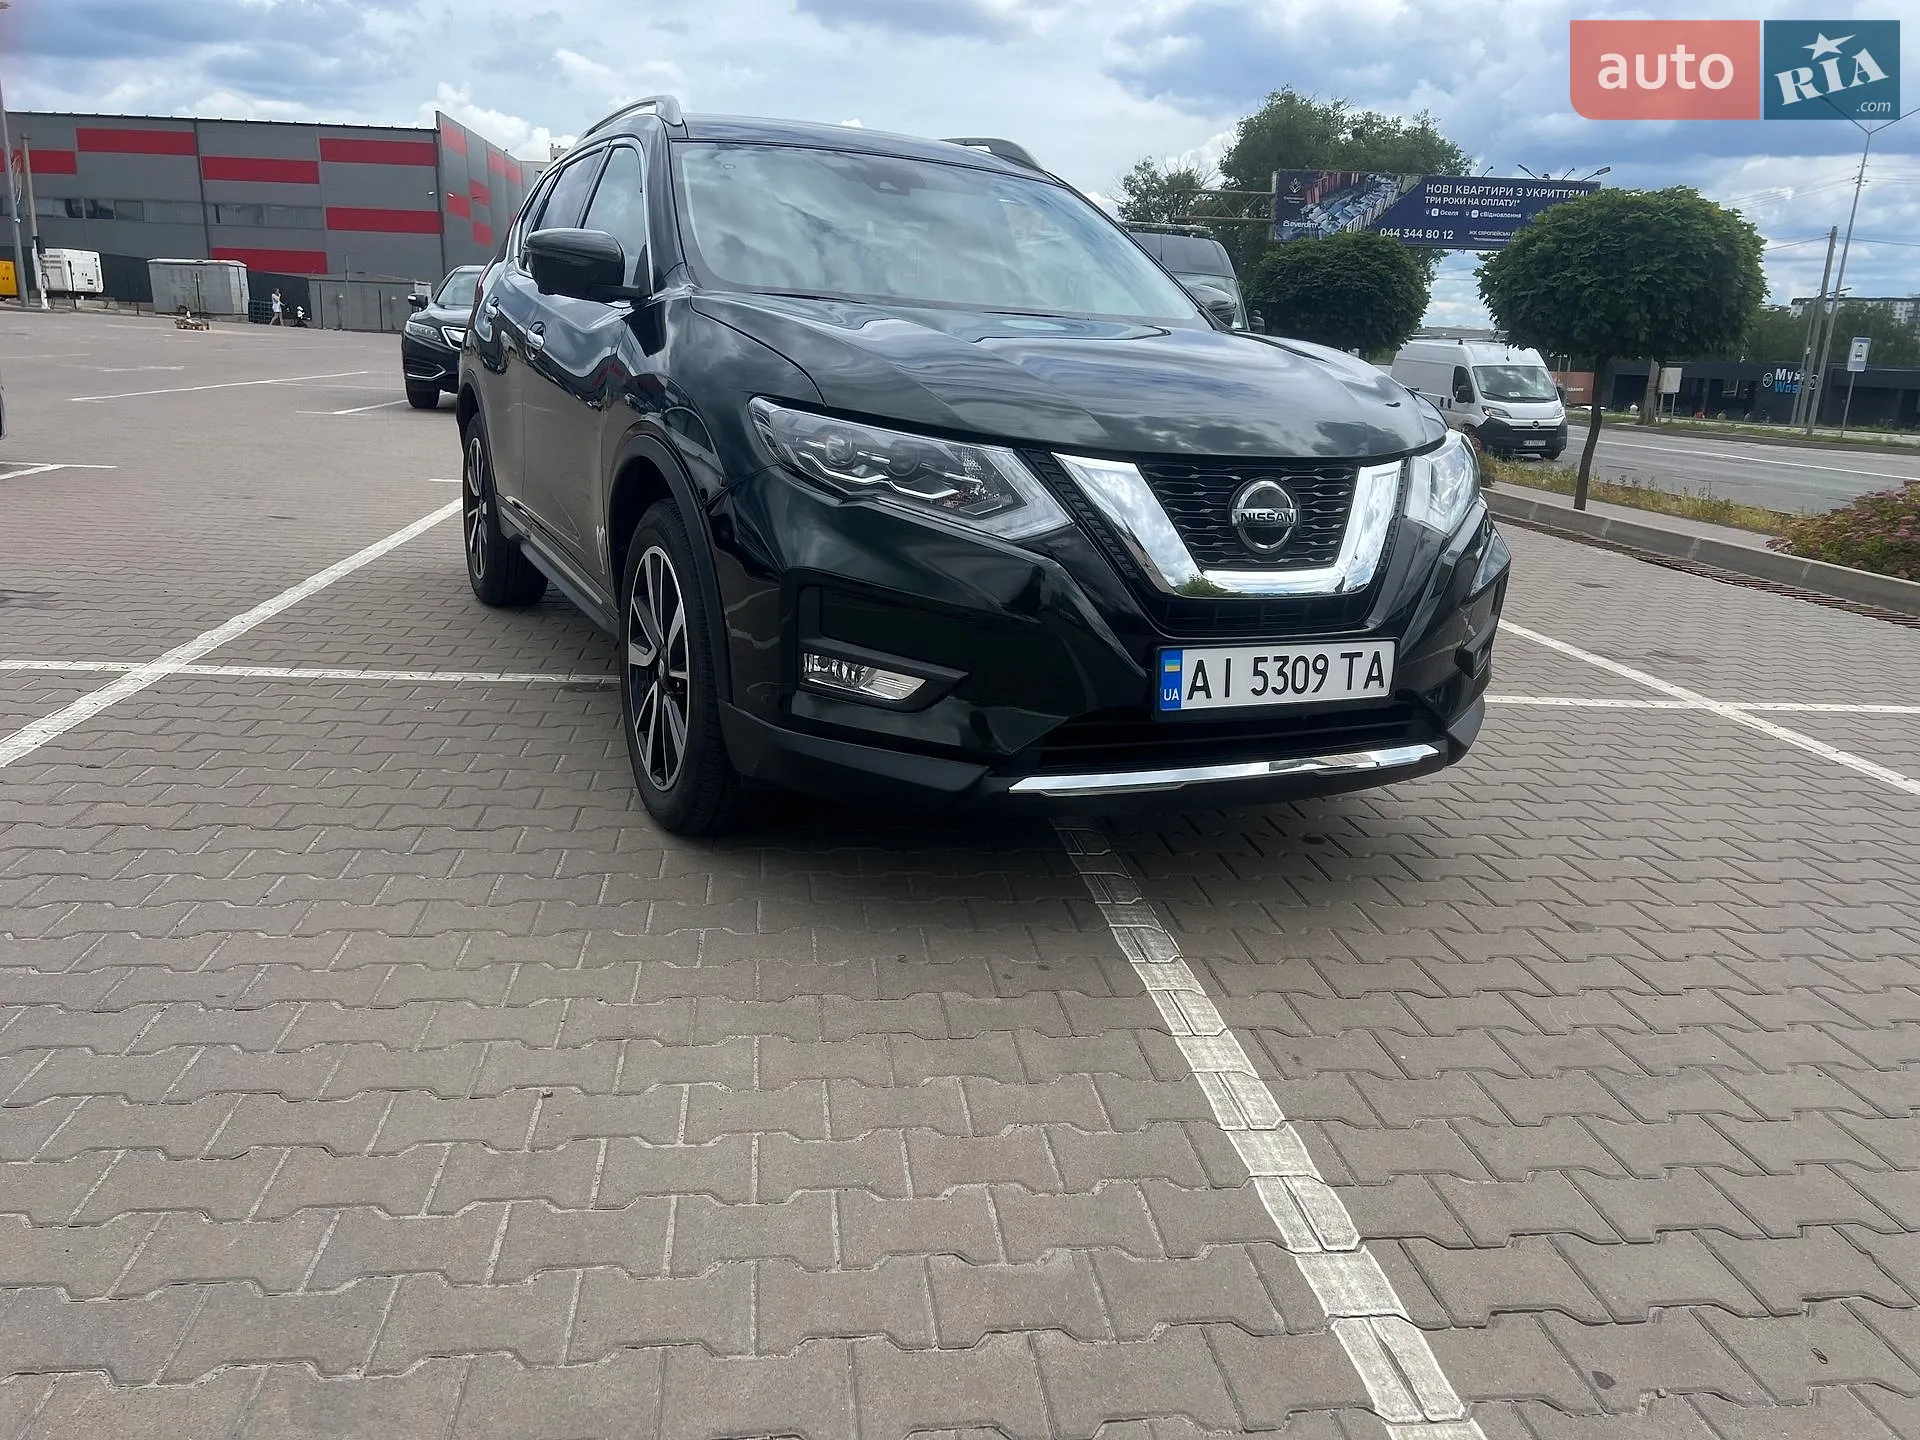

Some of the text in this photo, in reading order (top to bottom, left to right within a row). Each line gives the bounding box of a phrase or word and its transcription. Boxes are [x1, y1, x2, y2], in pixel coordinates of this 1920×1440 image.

[1426, 183, 1453, 194] НОВІ
[1455, 185, 1514, 196] КВАРТИРИ
[1516, 187, 1523, 196] З
[1425, 196, 1441, 204] ТРИ
[1442, 197, 1466, 205] РОКИ
[1467, 197, 1480, 205] НА
[1380, 227, 1454, 239] 044 344 80 12
[1240, 512, 1295, 523] NISSAN
[1187, 650, 1385, 700] AI 5309 TA
[1163, 687, 1180, 702] UA
